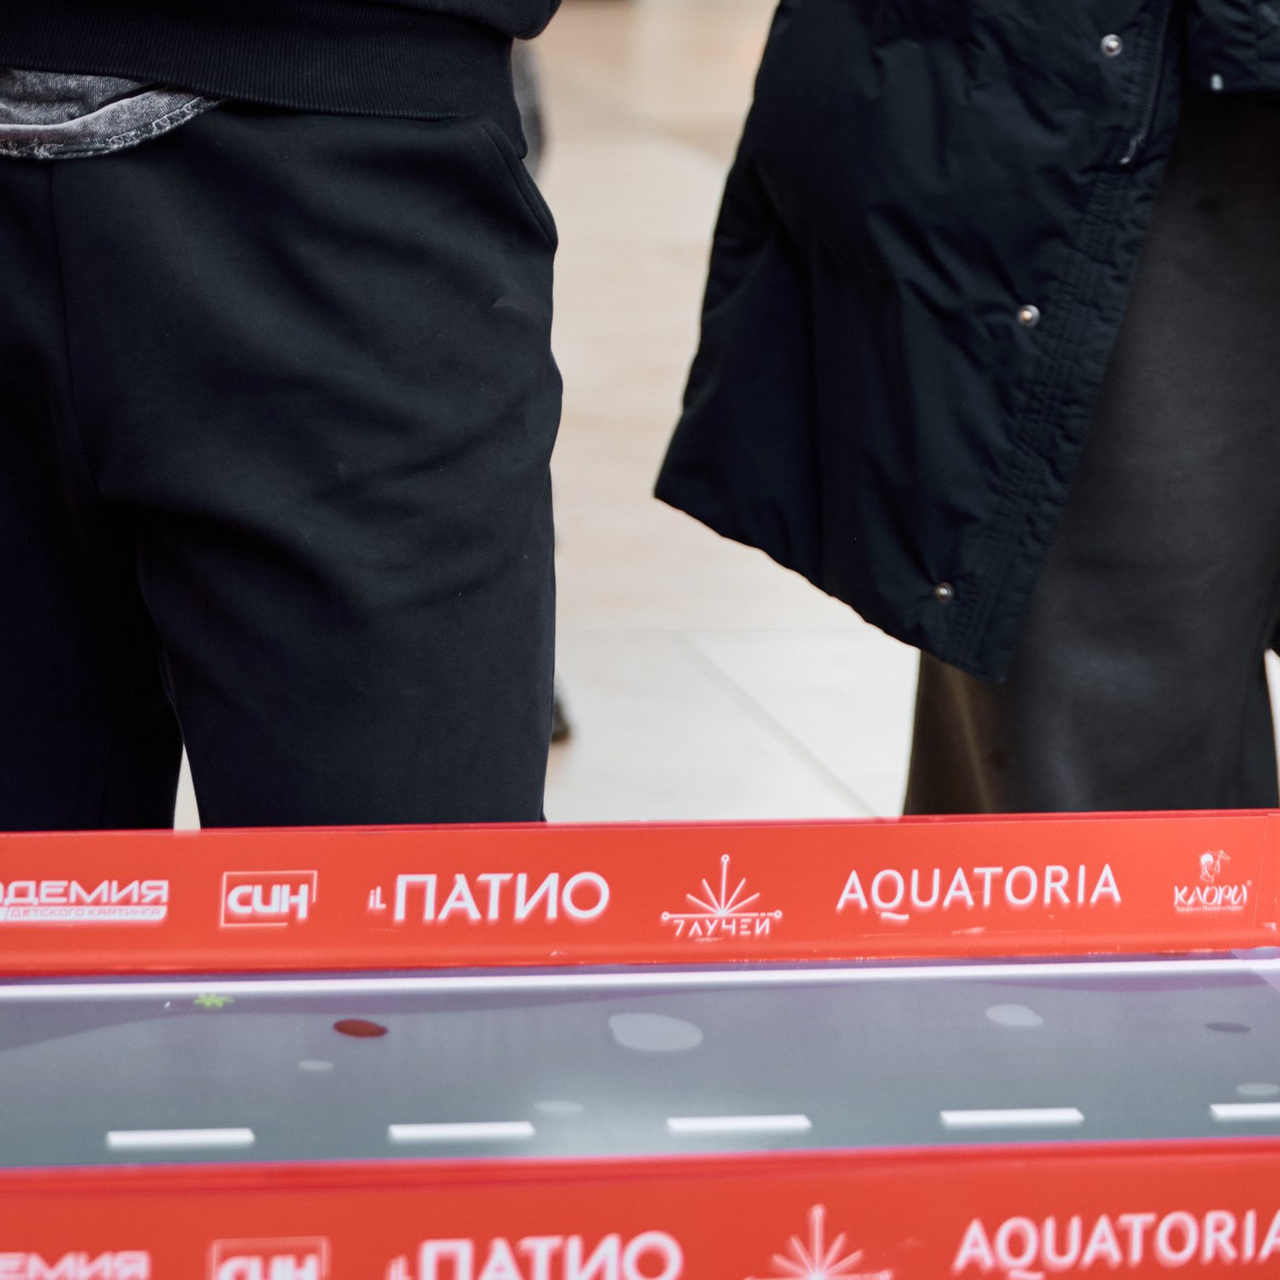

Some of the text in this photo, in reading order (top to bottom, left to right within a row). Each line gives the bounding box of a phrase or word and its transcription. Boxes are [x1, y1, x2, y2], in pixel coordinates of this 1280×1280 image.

[395, 872, 609, 921] ПАТИО
[837, 864, 1121, 921] AQUATORIA
[419, 1231, 683, 1280] ПАТИО
